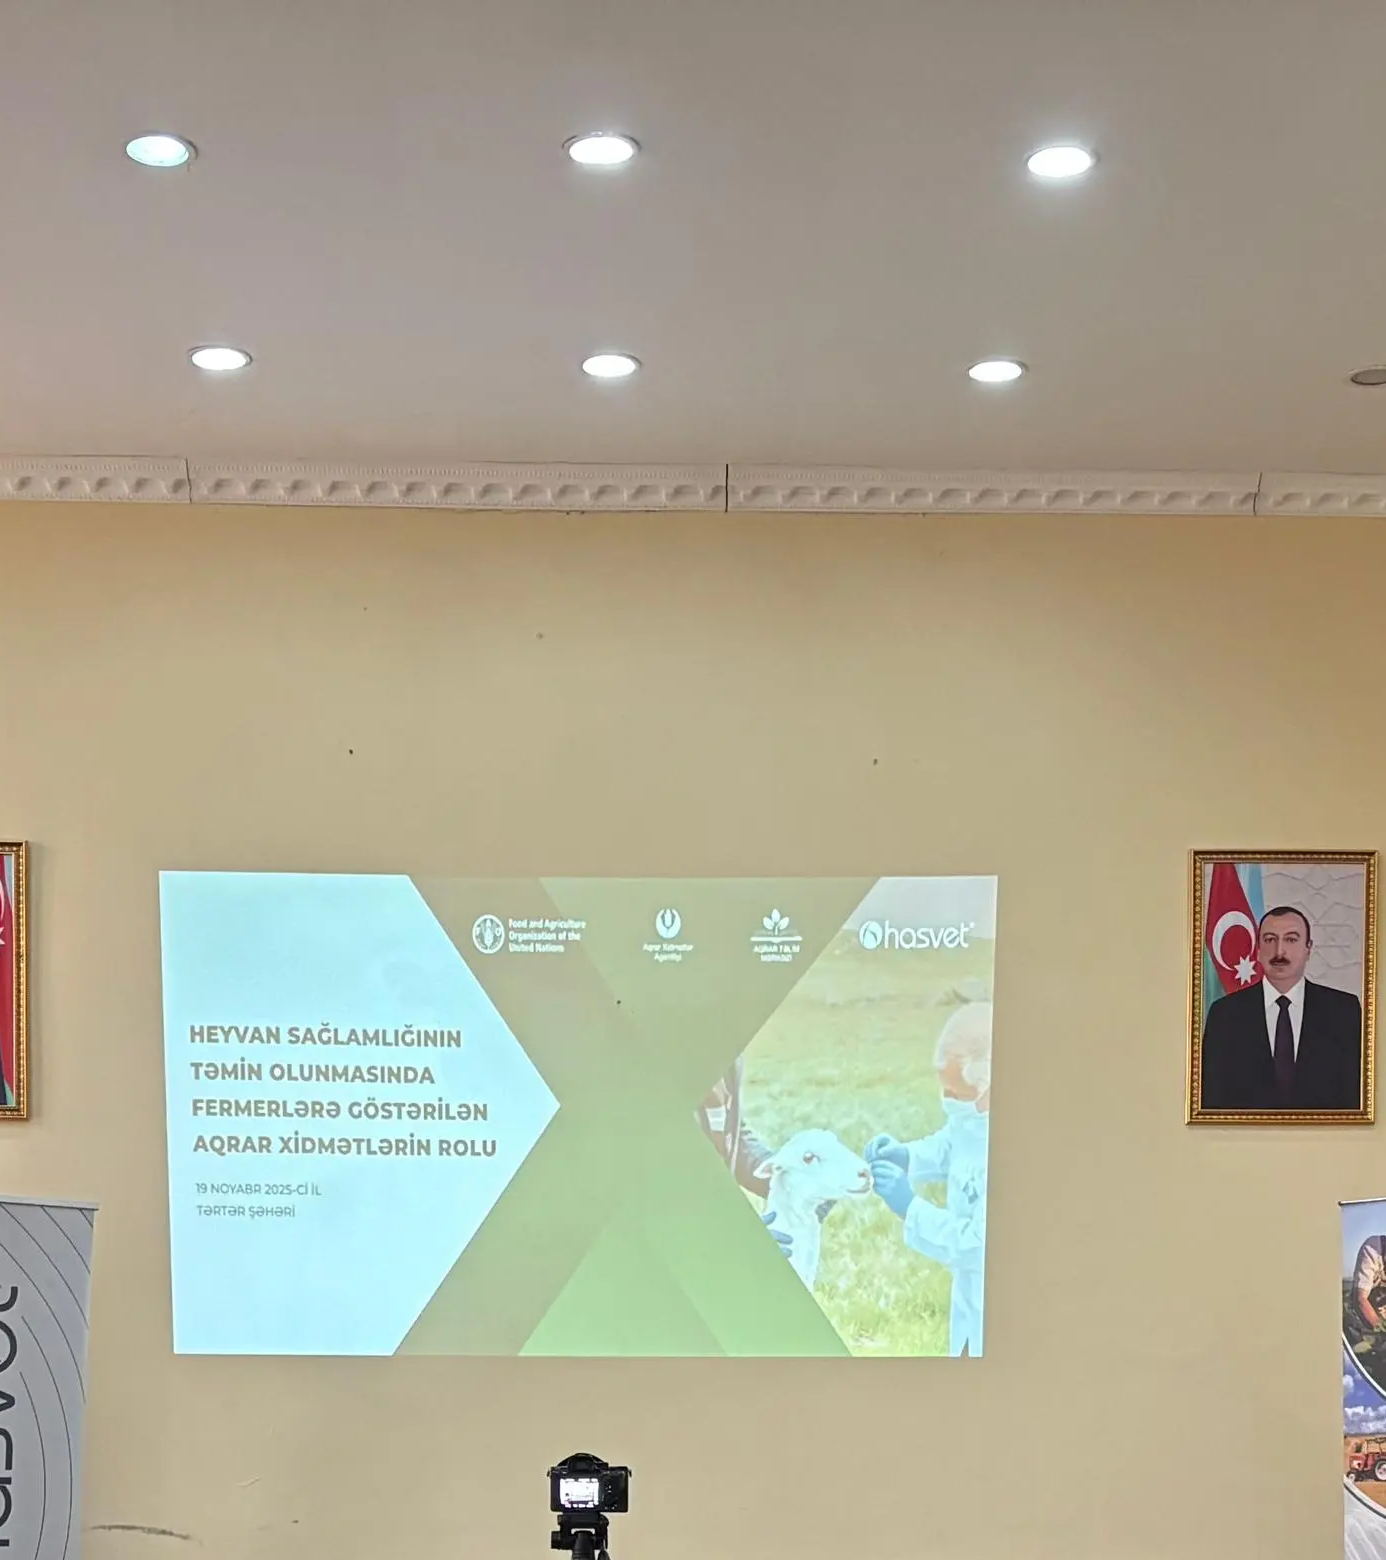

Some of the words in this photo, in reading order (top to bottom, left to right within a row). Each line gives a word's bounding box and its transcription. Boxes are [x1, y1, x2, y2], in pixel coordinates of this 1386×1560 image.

[189, 1025, 281, 1045] HEYVAN
[287, 1022, 462, 1048] SAĞLAMLIĞININ
[190, 1057, 262, 1081] TƏMİN
[269, 1062, 436, 1084] OLUNMASINDA
[191, 1098, 341, 1119] FERMERLƏRƏ
[348, 1097, 489, 1121] GÖSTƏRİLƏN
[193, 1135, 272, 1156] AQRAR
[278, 1131, 432, 1156] XİDMƏTLƏRİN
[438, 1139, 497, 1157] ROLU
[196, 1183, 208, 1194] 19
[210, 1183, 262, 1195] NOYABR
[264, 1182, 309, 1196] 2025-Cİ
[197, 1205, 246, 1217] TƏRTƏR
[248, 1204, 296, 1219] ŞƏHƏRİ
